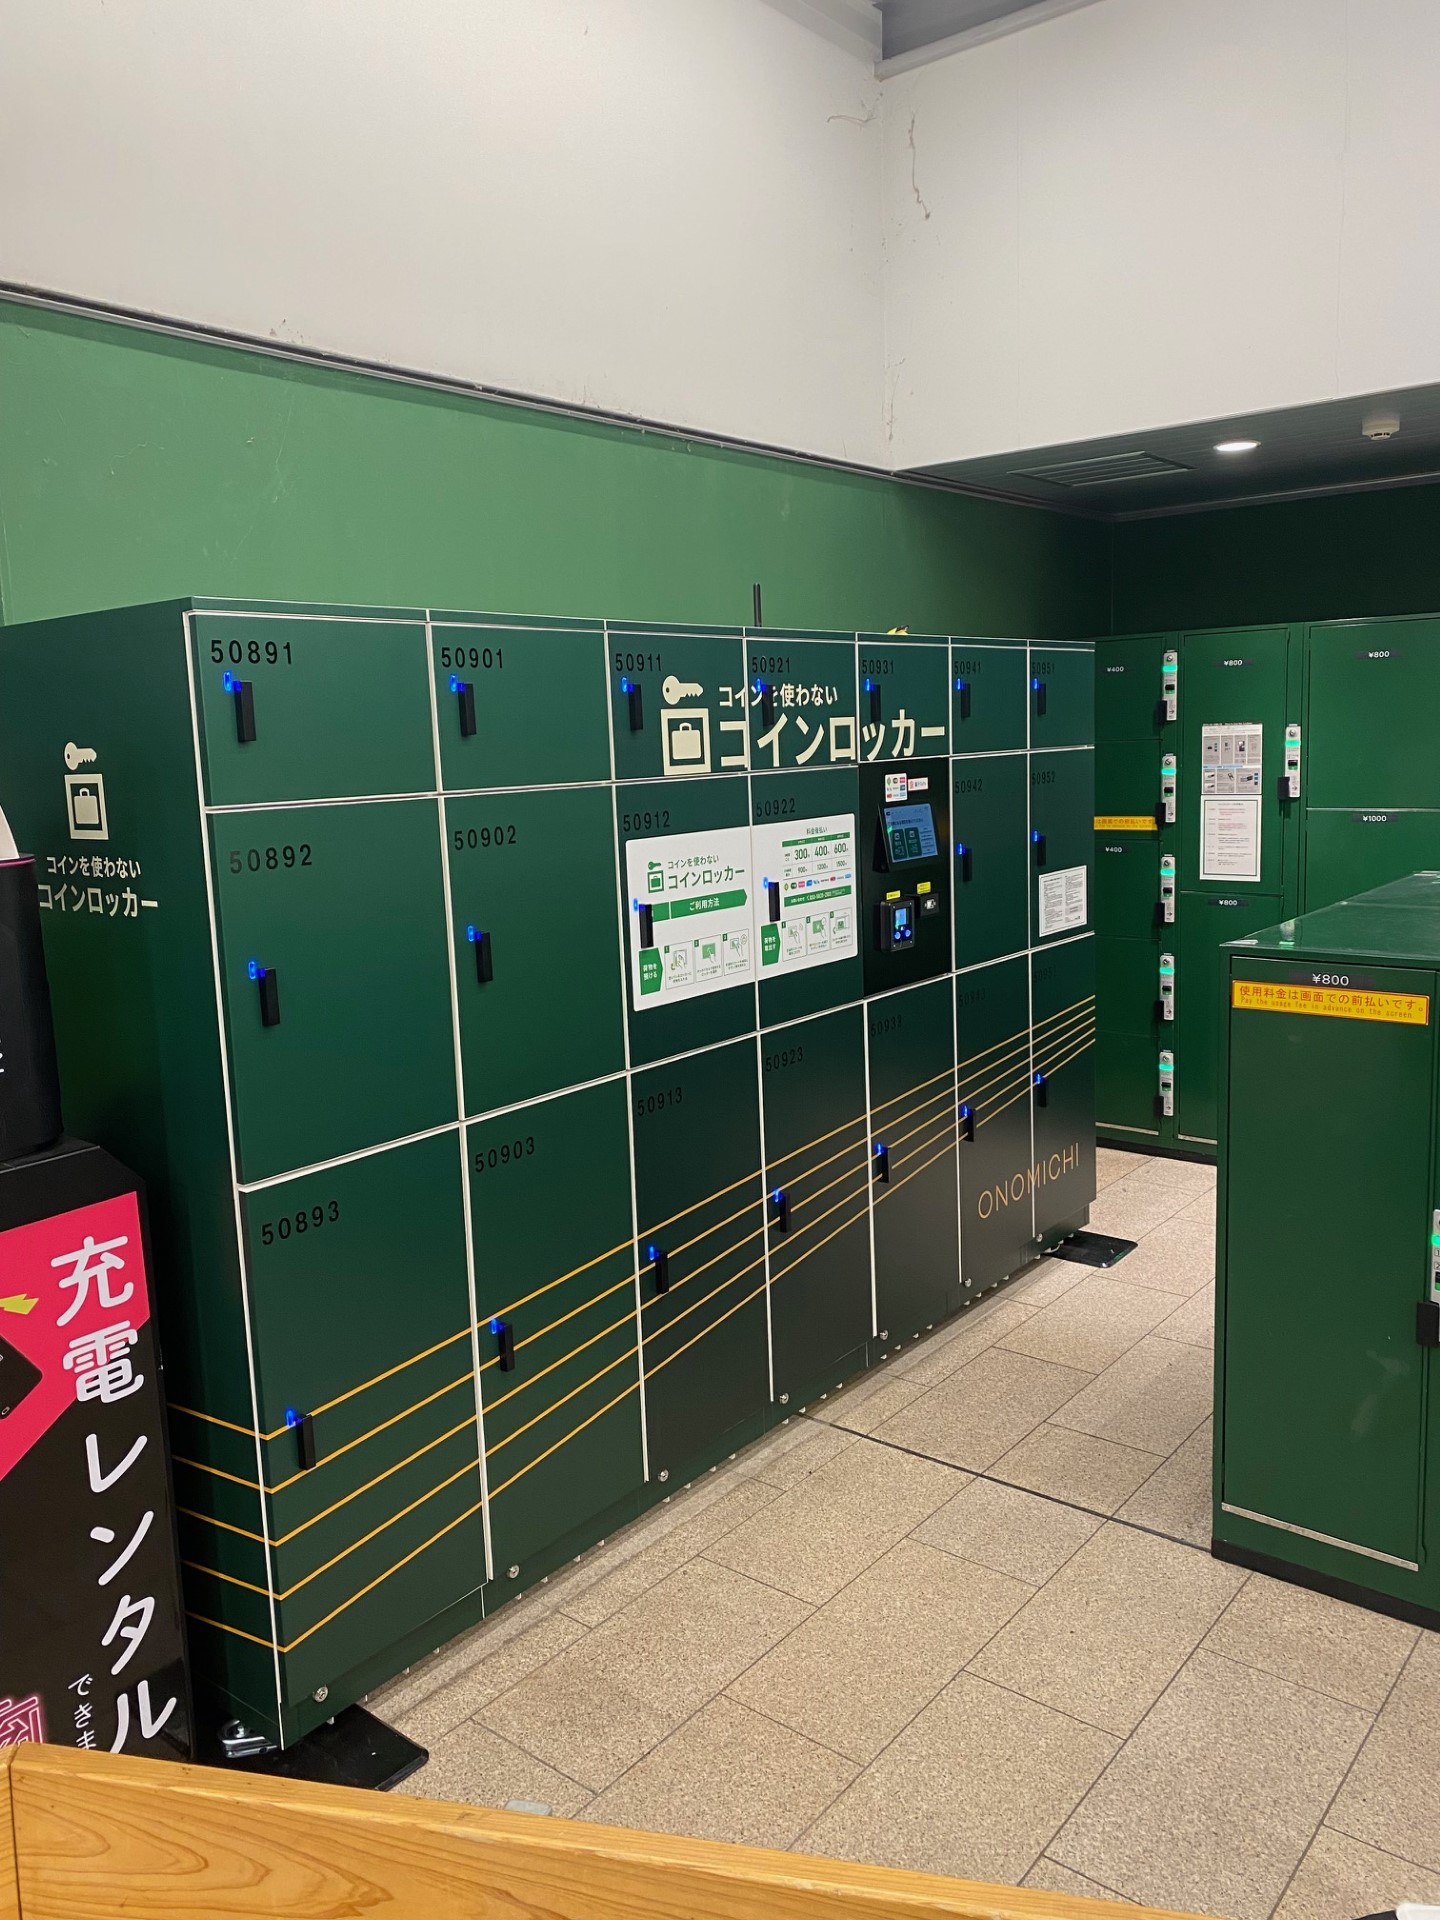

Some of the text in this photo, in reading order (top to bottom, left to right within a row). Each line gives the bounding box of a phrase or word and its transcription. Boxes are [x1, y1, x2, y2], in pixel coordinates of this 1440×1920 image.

[210, 640, 293, 665] 50891
[441, 647, 503, 669] 50901
[615, 653, 661, 671] 50911
[1224, 658, 1243, 667] ¥800
[1368, 650, 1390, 658] ¥800
[752, 657, 791, 673] 50921
[862, 660, 894, 674] 50931
[954, 661, 981, 674] 50941
[720, 709, 945, 768] コインロッカー
[955, 779, 982, 794] 50942
[756, 798, 796, 817] 50922
[1362, 814, 1387, 822] ¥1000
[622, 811, 670, 832] 50912
[454, 825, 516, 850] 50902
[46, 856, 141, 880] コインを使わない
[229, 844, 313, 875] 50892
[668, 855, 719, 869] コインを使わない
[668, 866, 745, 890] コインロッカー
[38, 884, 158, 917] コインロッカー
[689, 898, 720, 911] ご利用方法
[1312, 974, 1350, 986] ¥800
[1240, 986, 1424, 1012] 使用料金は画面での前払いです。
[1323, 1004, 1352, 1013] advance
[766, 1046, 803, 1072] 50923
[637, 1086, 684, 1117] 50913
[474, 1136, 536, 1173] 50903
[978, 1142, 1079, 1218] ONOMICHI
[261, 1200, 341, 1246] 50893
[50, 1235, 177, 1754] 充電レンタル
